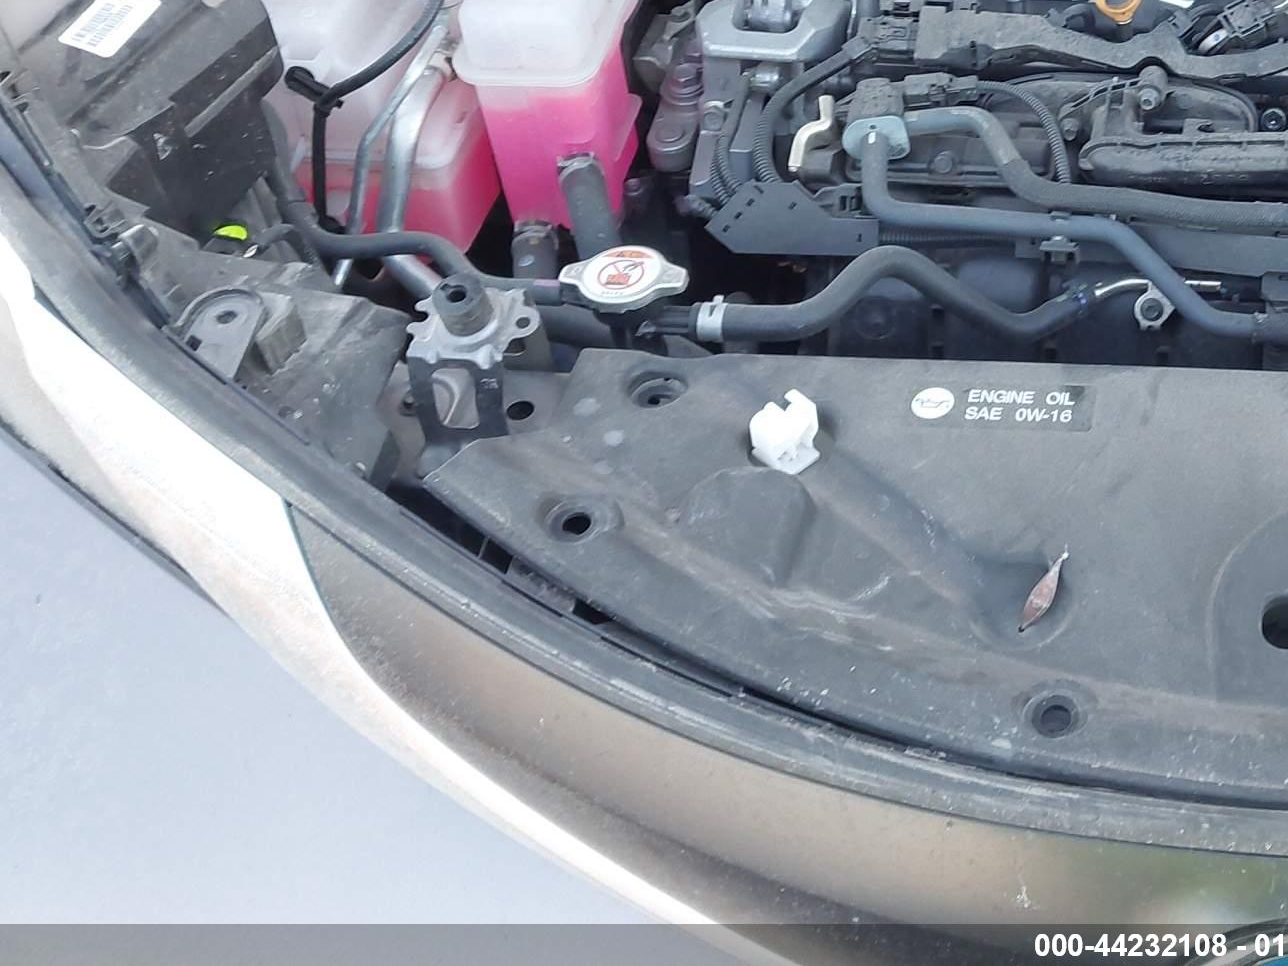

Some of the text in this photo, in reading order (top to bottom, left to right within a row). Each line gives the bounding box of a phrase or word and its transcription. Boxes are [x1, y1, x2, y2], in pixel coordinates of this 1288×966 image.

[967, 388, 1076, 406] ENGINE OIL
[964, 406, 1073, 423] SAE 0W-16
